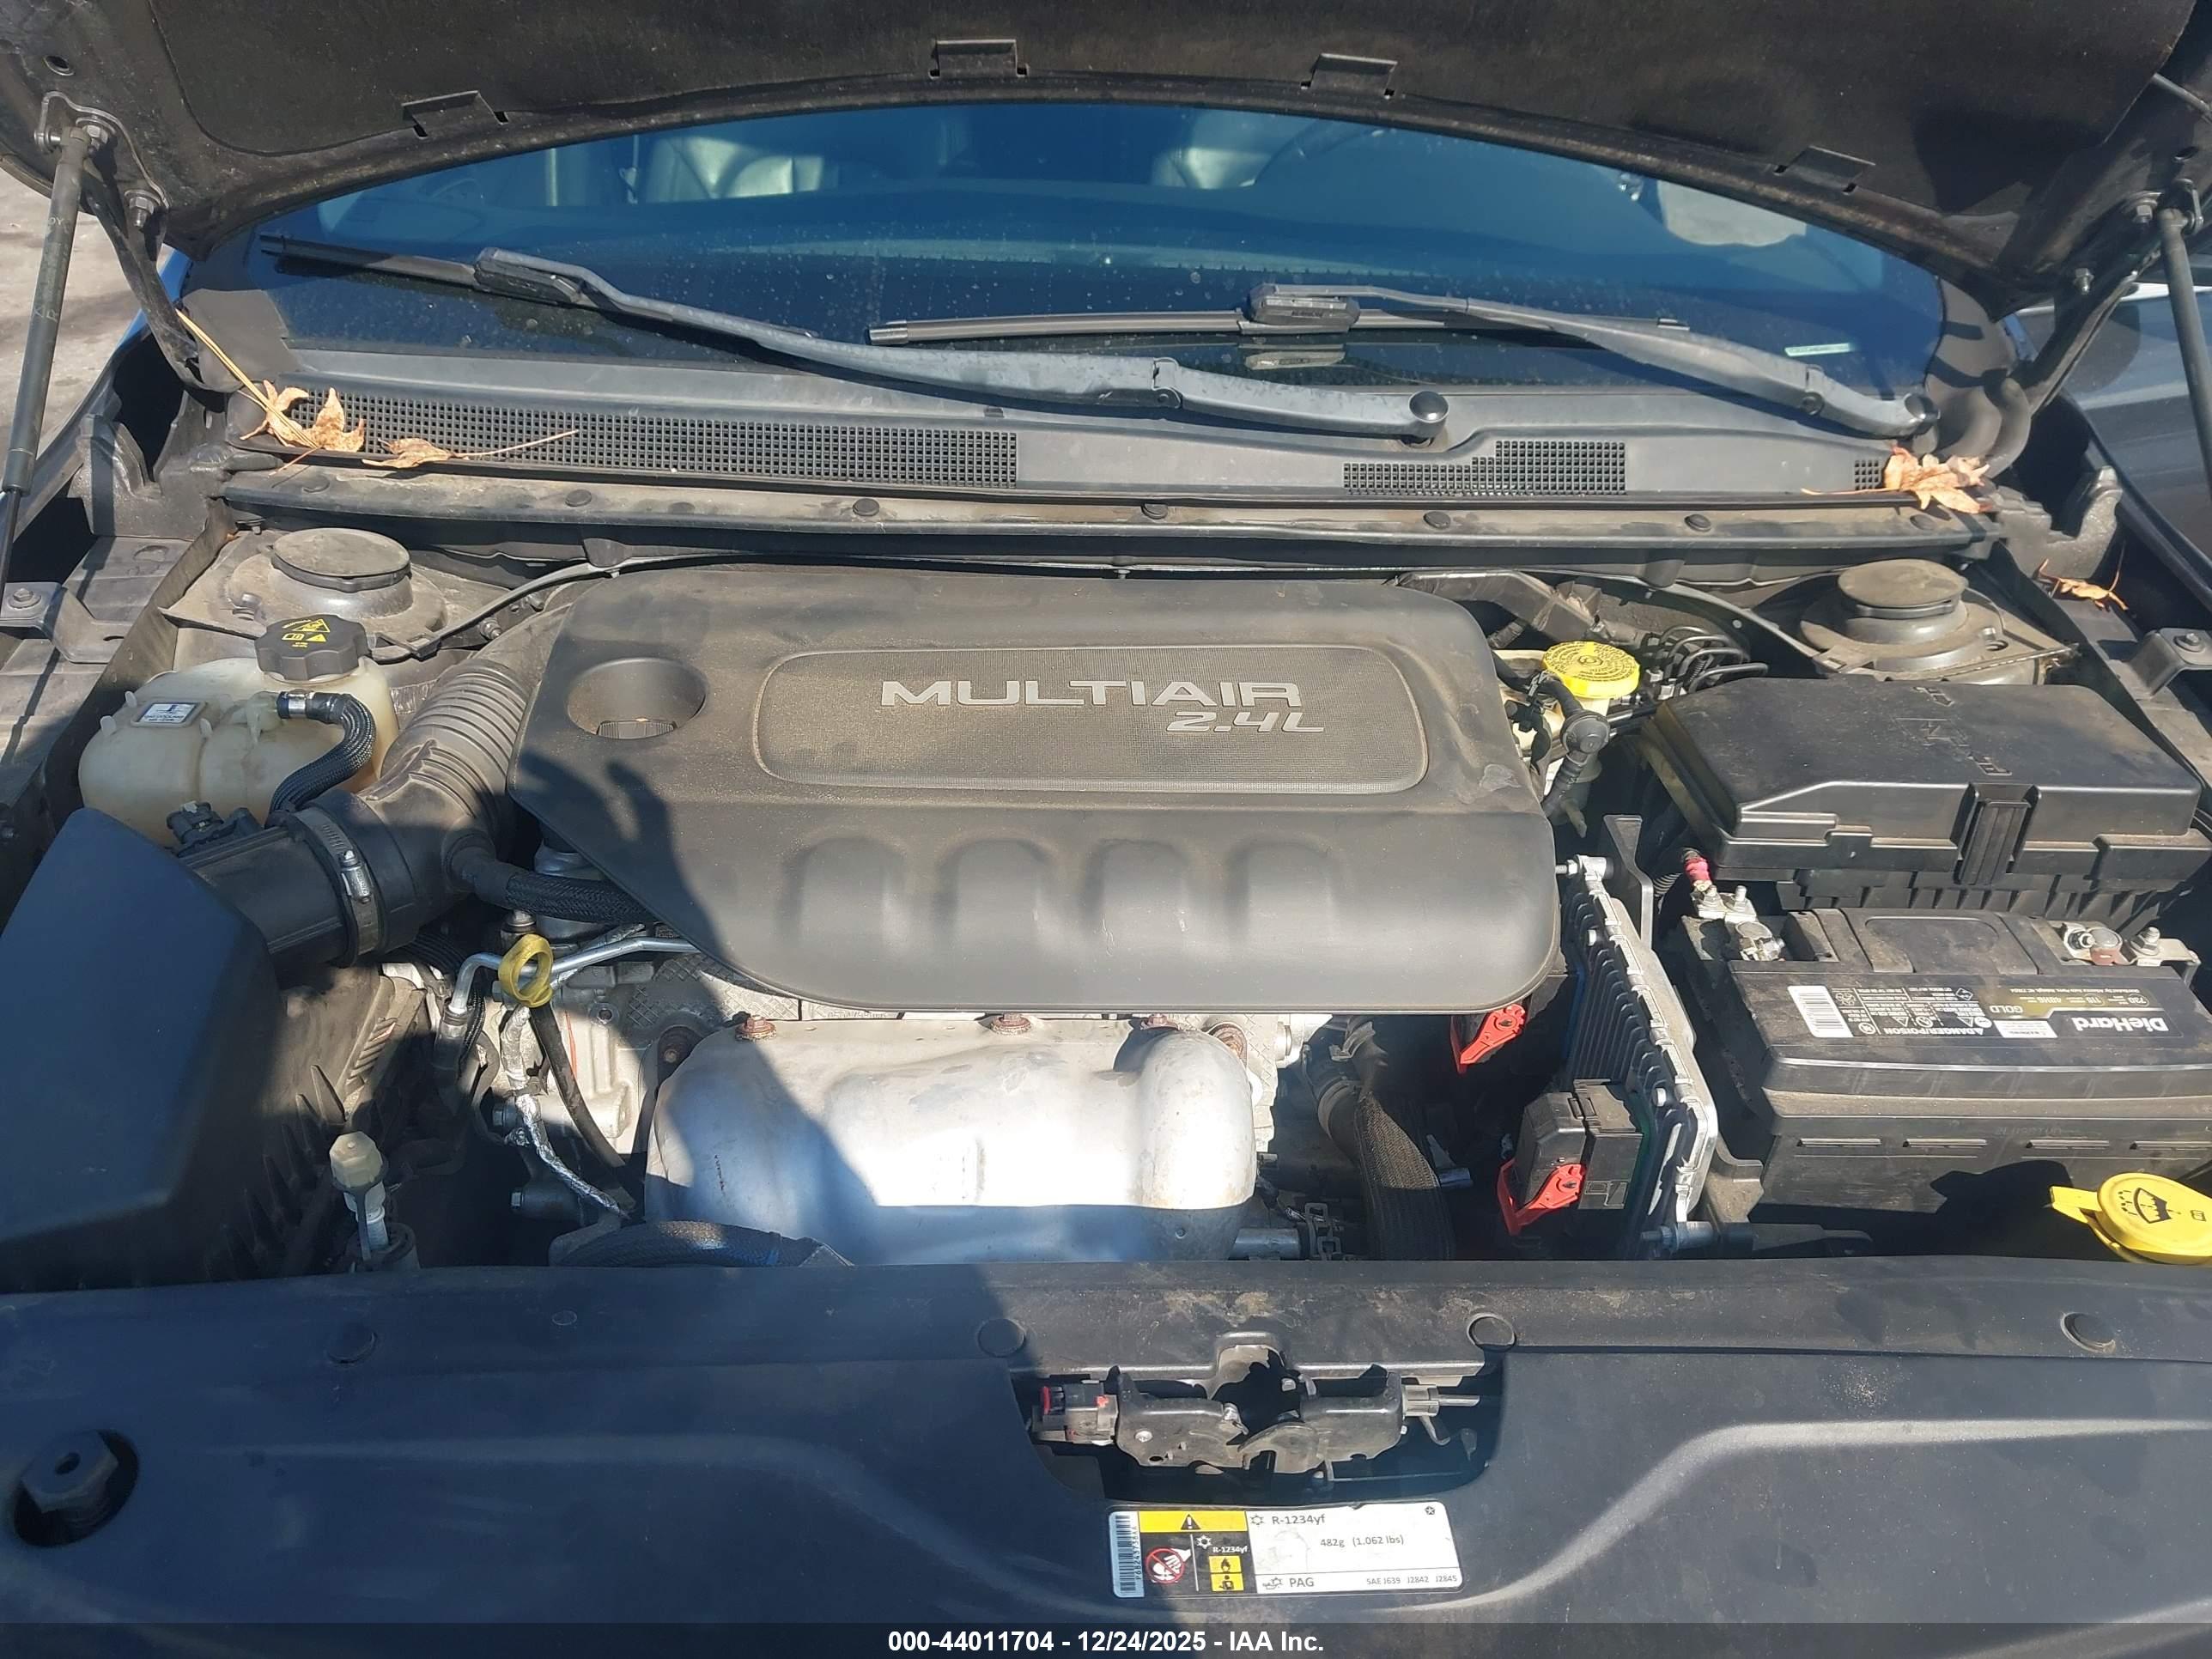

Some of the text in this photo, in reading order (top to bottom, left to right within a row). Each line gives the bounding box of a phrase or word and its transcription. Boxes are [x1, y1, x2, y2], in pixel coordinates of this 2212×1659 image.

[881, 680, 1303, 707] MULTIAIR
[1166, 711, 1324, 732] 2.4L
[1989, 1004, 2024, 1014] GOLD
[2071, 1017, 2169, 1032] DieHard
[1272, 1513, 1326, 1528] R-1234yf
[1320, 1534, 1404, 1548] 482g (1.062 lbs)
[1212, 1545, 1249, 1555] R-1234yf
[1289, 1577, 1314, 1588] PAG
